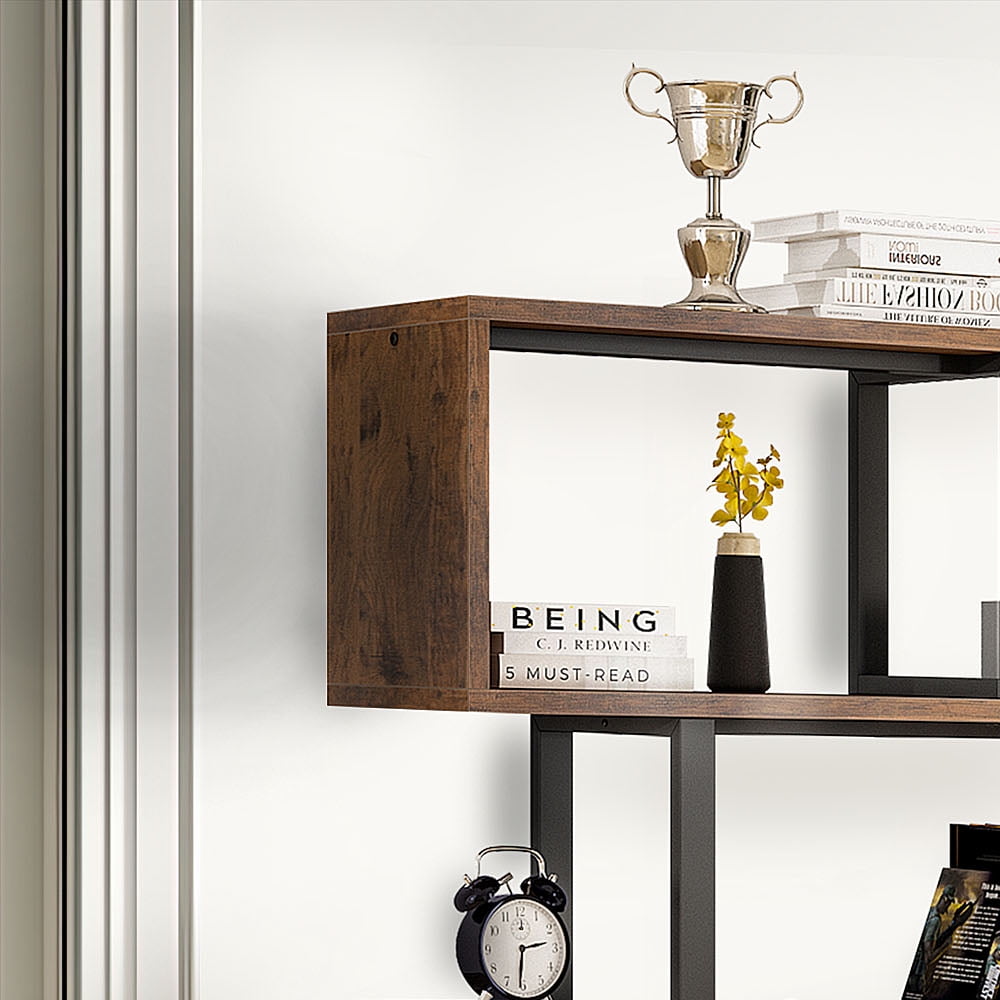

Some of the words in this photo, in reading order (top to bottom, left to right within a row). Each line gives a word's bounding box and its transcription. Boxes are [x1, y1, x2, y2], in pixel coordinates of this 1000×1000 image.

[512, 606, 656, 633] BEING
[536, 638, 550, 650] C.
[557, 638, 567, 651] J.
[574, 640, 651, 653] REDWINE
[505, 666, 515, 680] 5
[526, 667, 650, 683] MUST-READ
[502, 911, 509, 922] 11
[516, 906, 525, 917] 12
[490, 925, 500, 937] 10
[546, 923, 553, 934] 2
[485, 944, 492, 956] 9
[552, 943, 559, 953] 3
[490, 962, 497, 974] 8
[504, 975, 511, 987] 7
